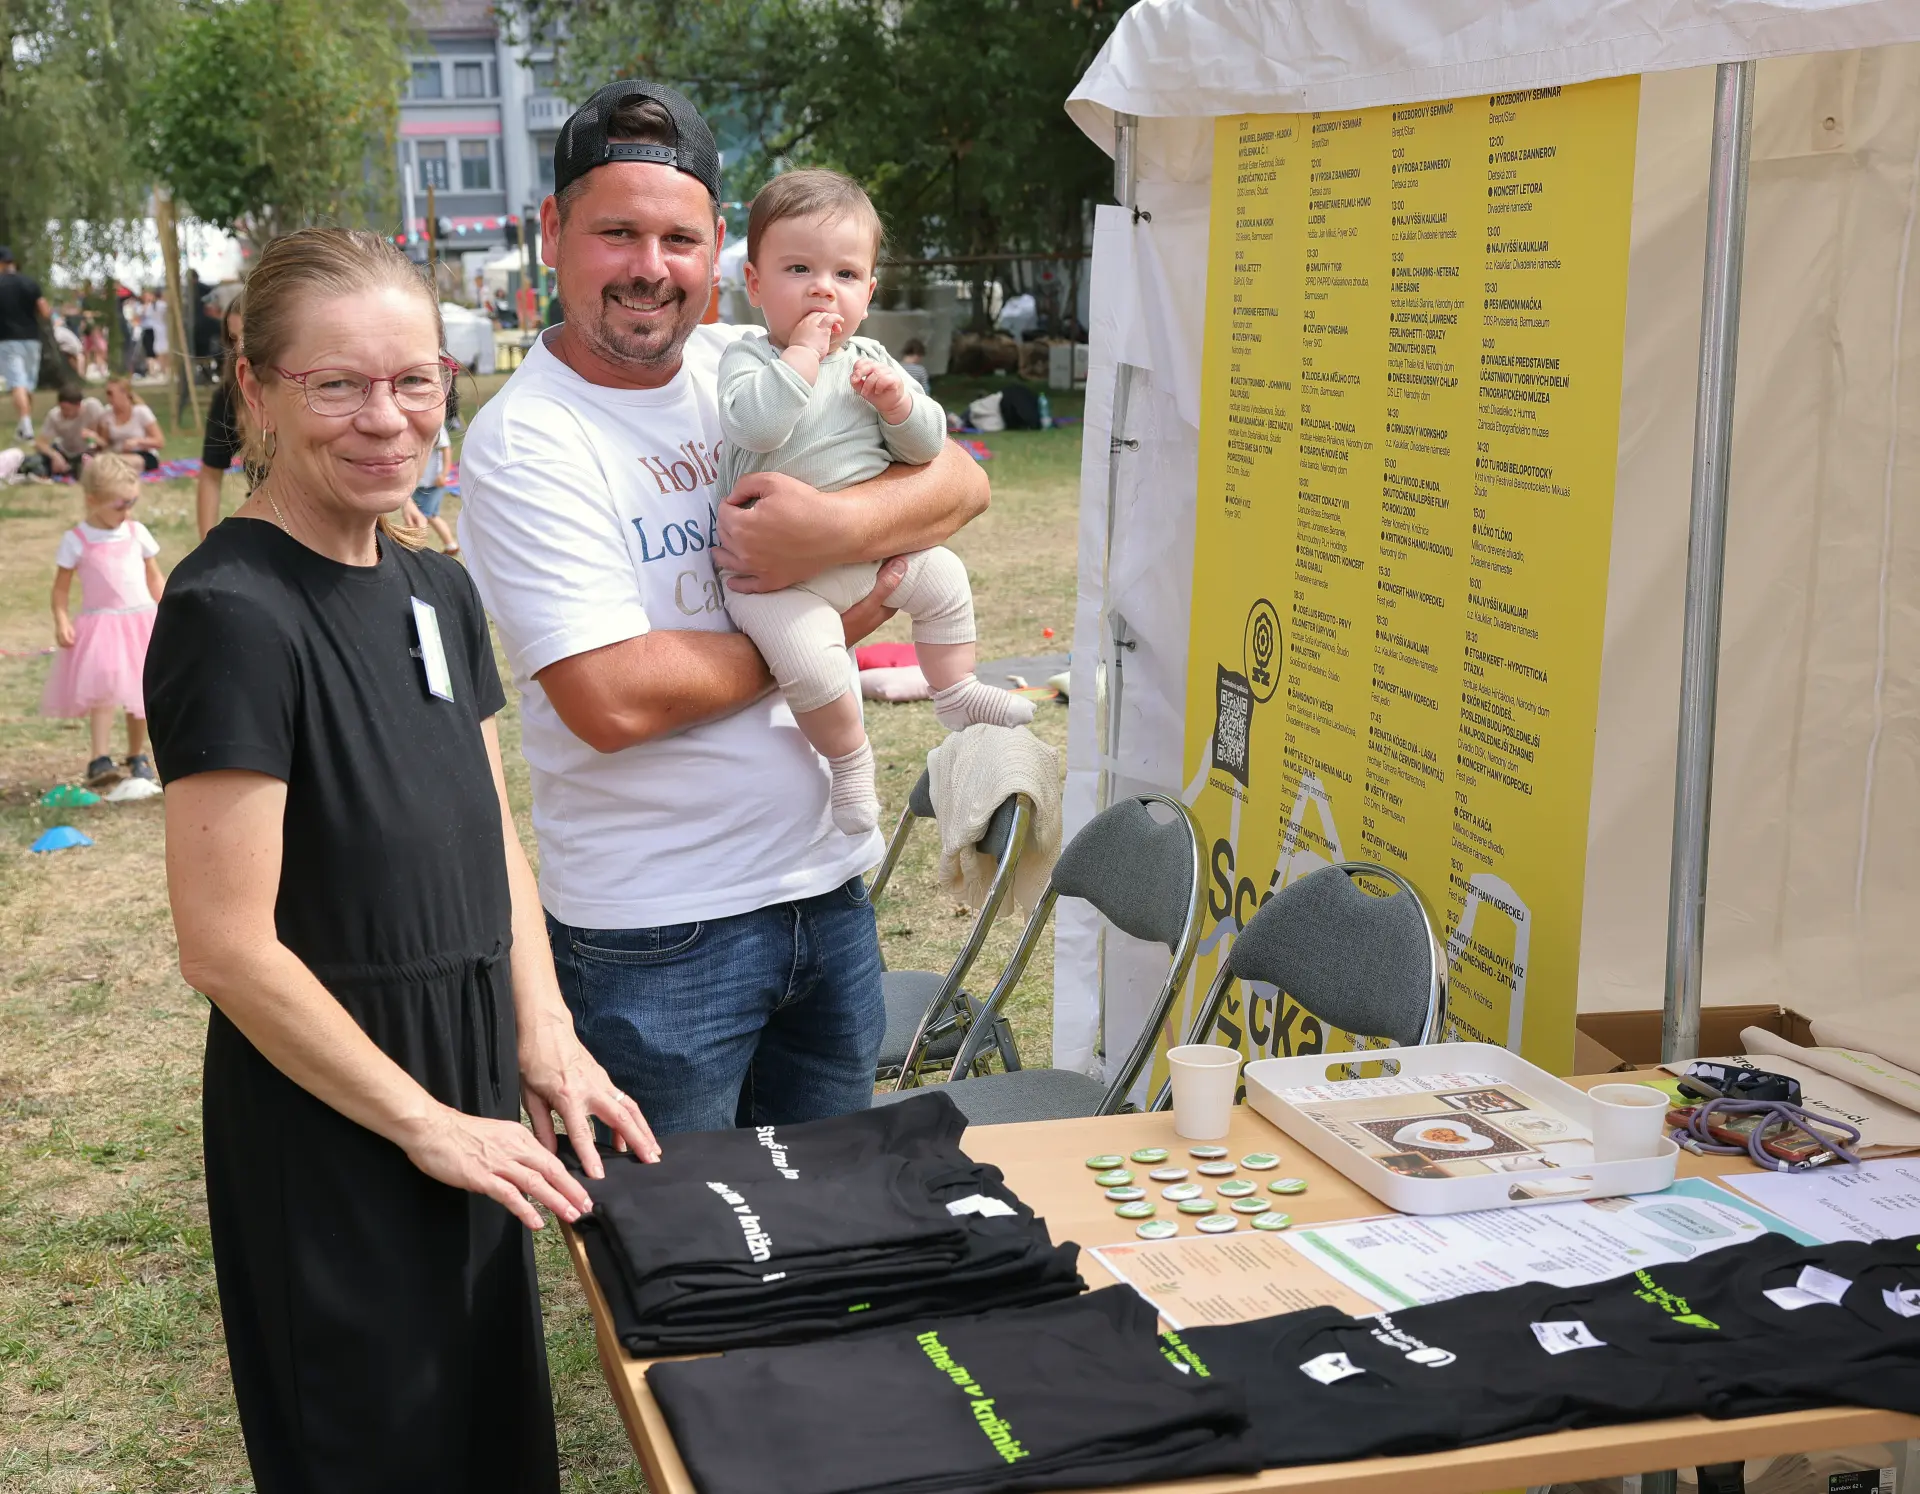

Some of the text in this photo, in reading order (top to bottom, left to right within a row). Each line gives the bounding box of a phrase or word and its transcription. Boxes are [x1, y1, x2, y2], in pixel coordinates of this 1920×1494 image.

[1494, 182, 1543, 197] KONCERT LETORA
[1487, 226, 1500, 237] 13:00
[1516, 357, 1560, 370] PREDSTAVENIE
[631, 517, 705, 563] Los
[1382, 581, 1445, 608] KONCERT HANY KOPECKEJ
[1377, 680, 1439, 711] KONCERT HANY KOPECKEJ
[1462, 755, 1533, 796] KONCERT HANY KOPECKEJ
[1455, 875, 1524, 922] KONCERT HANY KOPECKEJ
[963, 1383, 984, 1397] v
